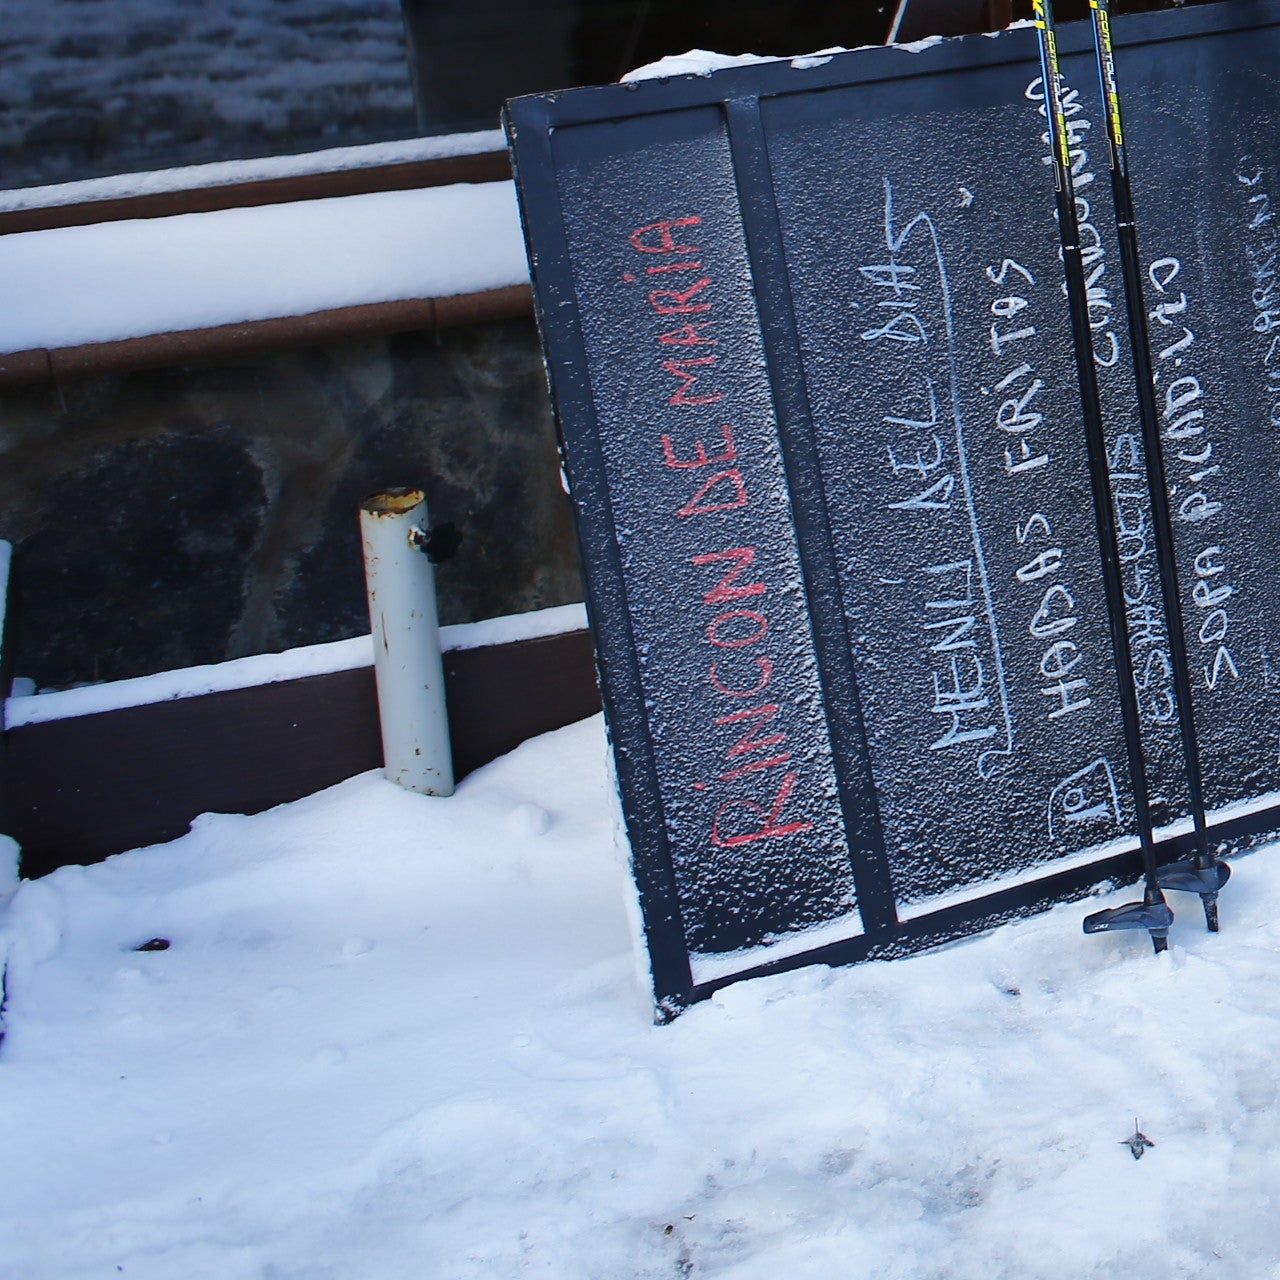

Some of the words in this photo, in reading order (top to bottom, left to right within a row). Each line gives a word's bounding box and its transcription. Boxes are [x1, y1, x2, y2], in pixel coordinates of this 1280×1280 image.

[661, 423, 748, 518] DE
[882, 376, 955, 511] DEL
[1191, 543, 1242, 690] SOPA
